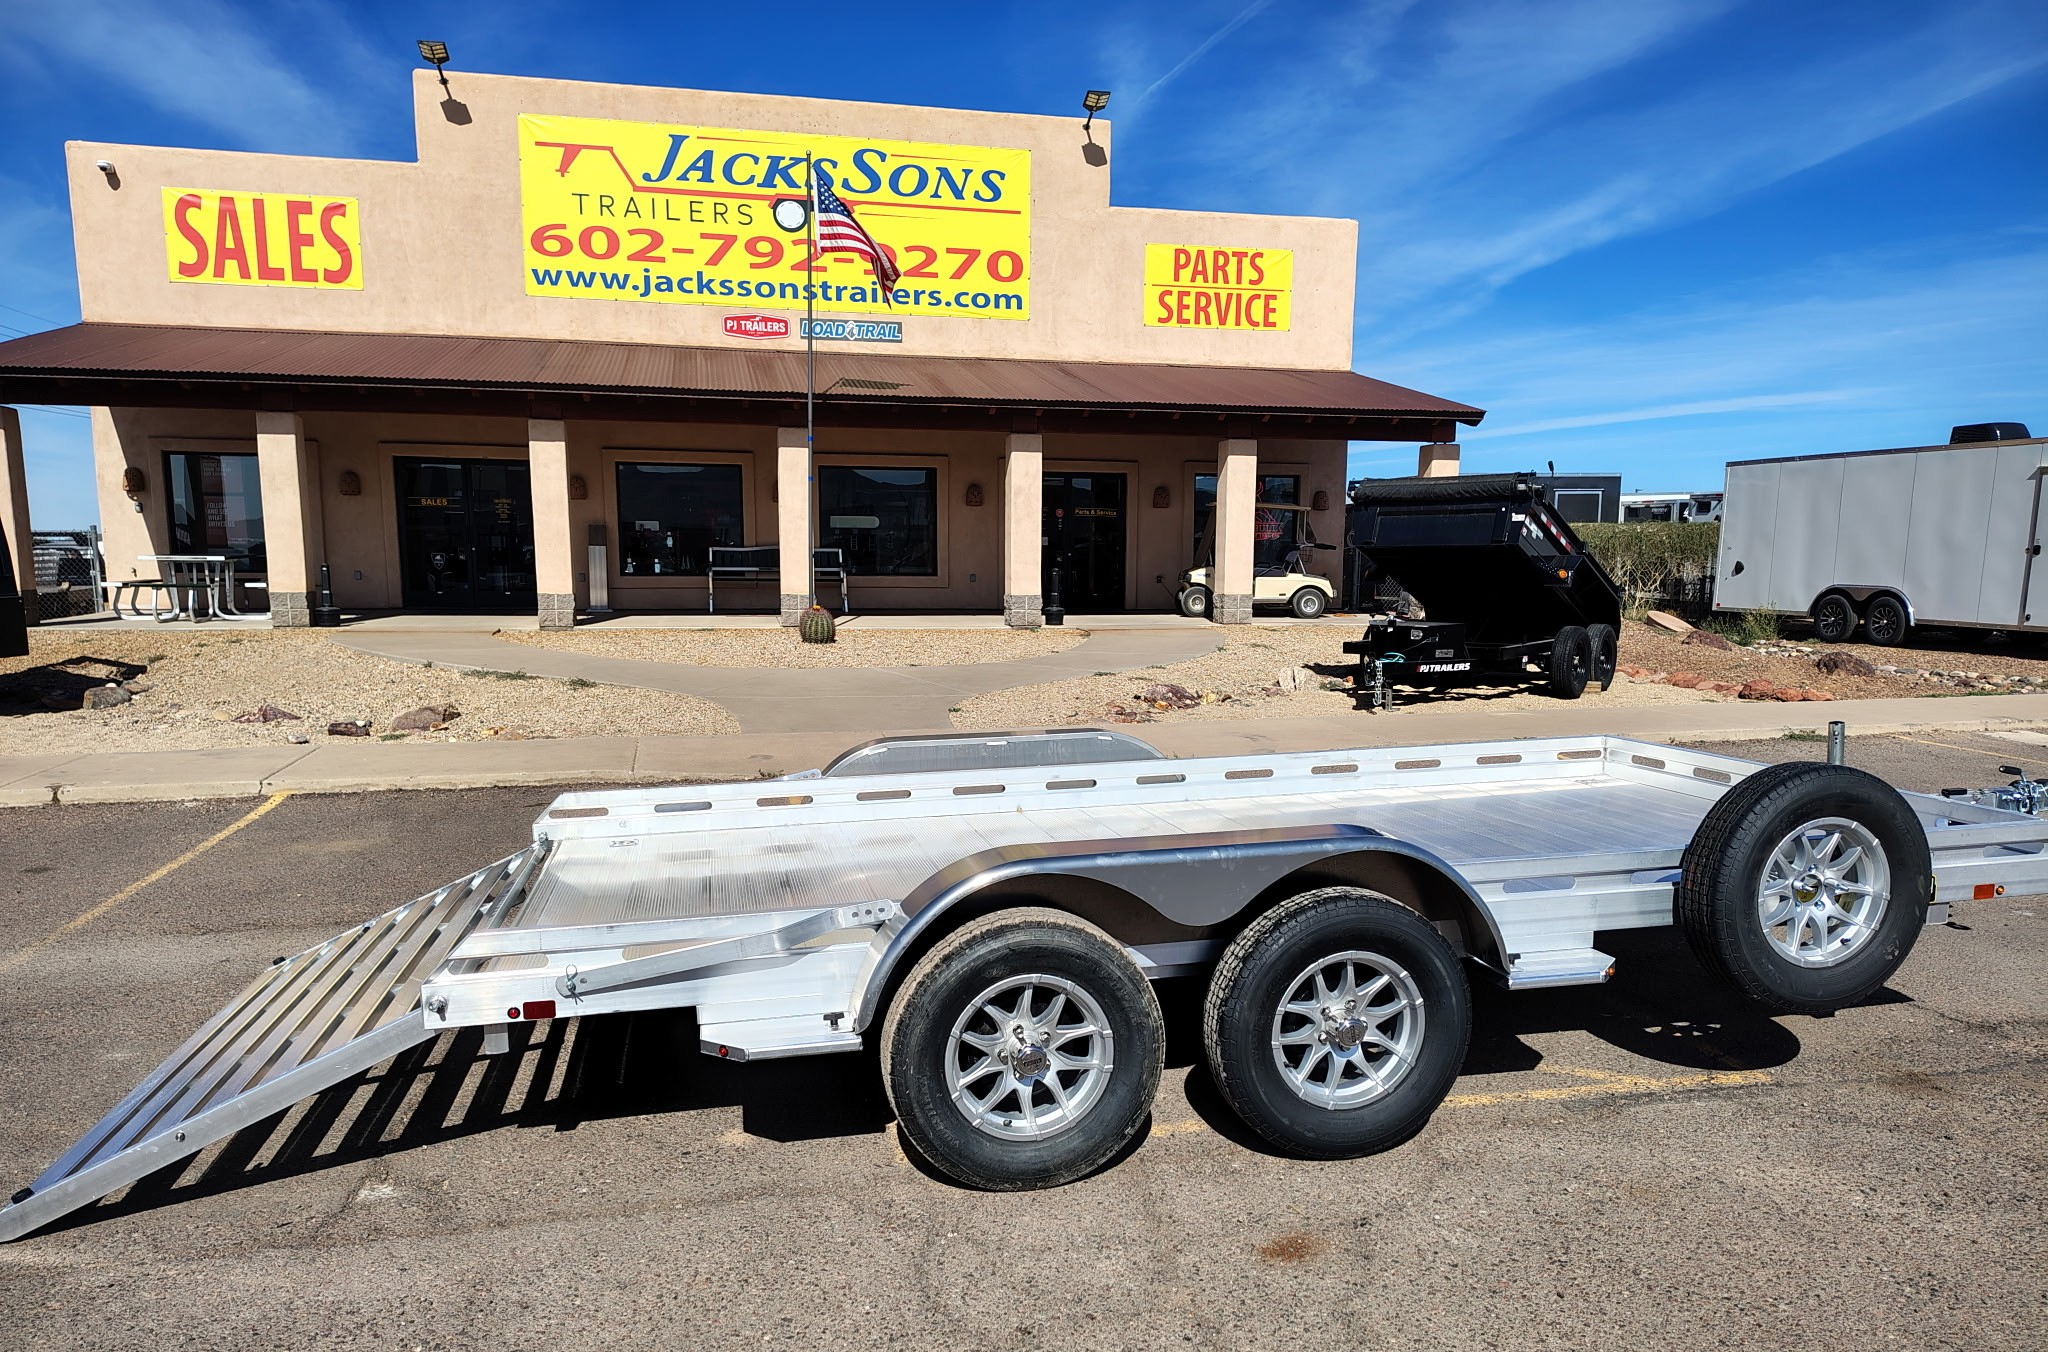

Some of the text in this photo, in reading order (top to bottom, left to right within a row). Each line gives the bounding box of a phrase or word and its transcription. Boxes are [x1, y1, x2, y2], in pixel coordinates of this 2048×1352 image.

[572, 192, 753, 226] TRAILERS
[174, 193, 353, 284] SALES
[1173, 248, 1265, 286] PARTS
[531, 267, 1023, 311] www.jackssonstraiers.com
[1157, 289, 1278, 328] SERVICE
[726, 320, 786, 333] PJ TRAILERS
[802, 321, 901, 339] LOAD TRAIL
[421, 498, 448, 506] SALES
[1419, 662, 1471, 673] PJ TRAILERS
